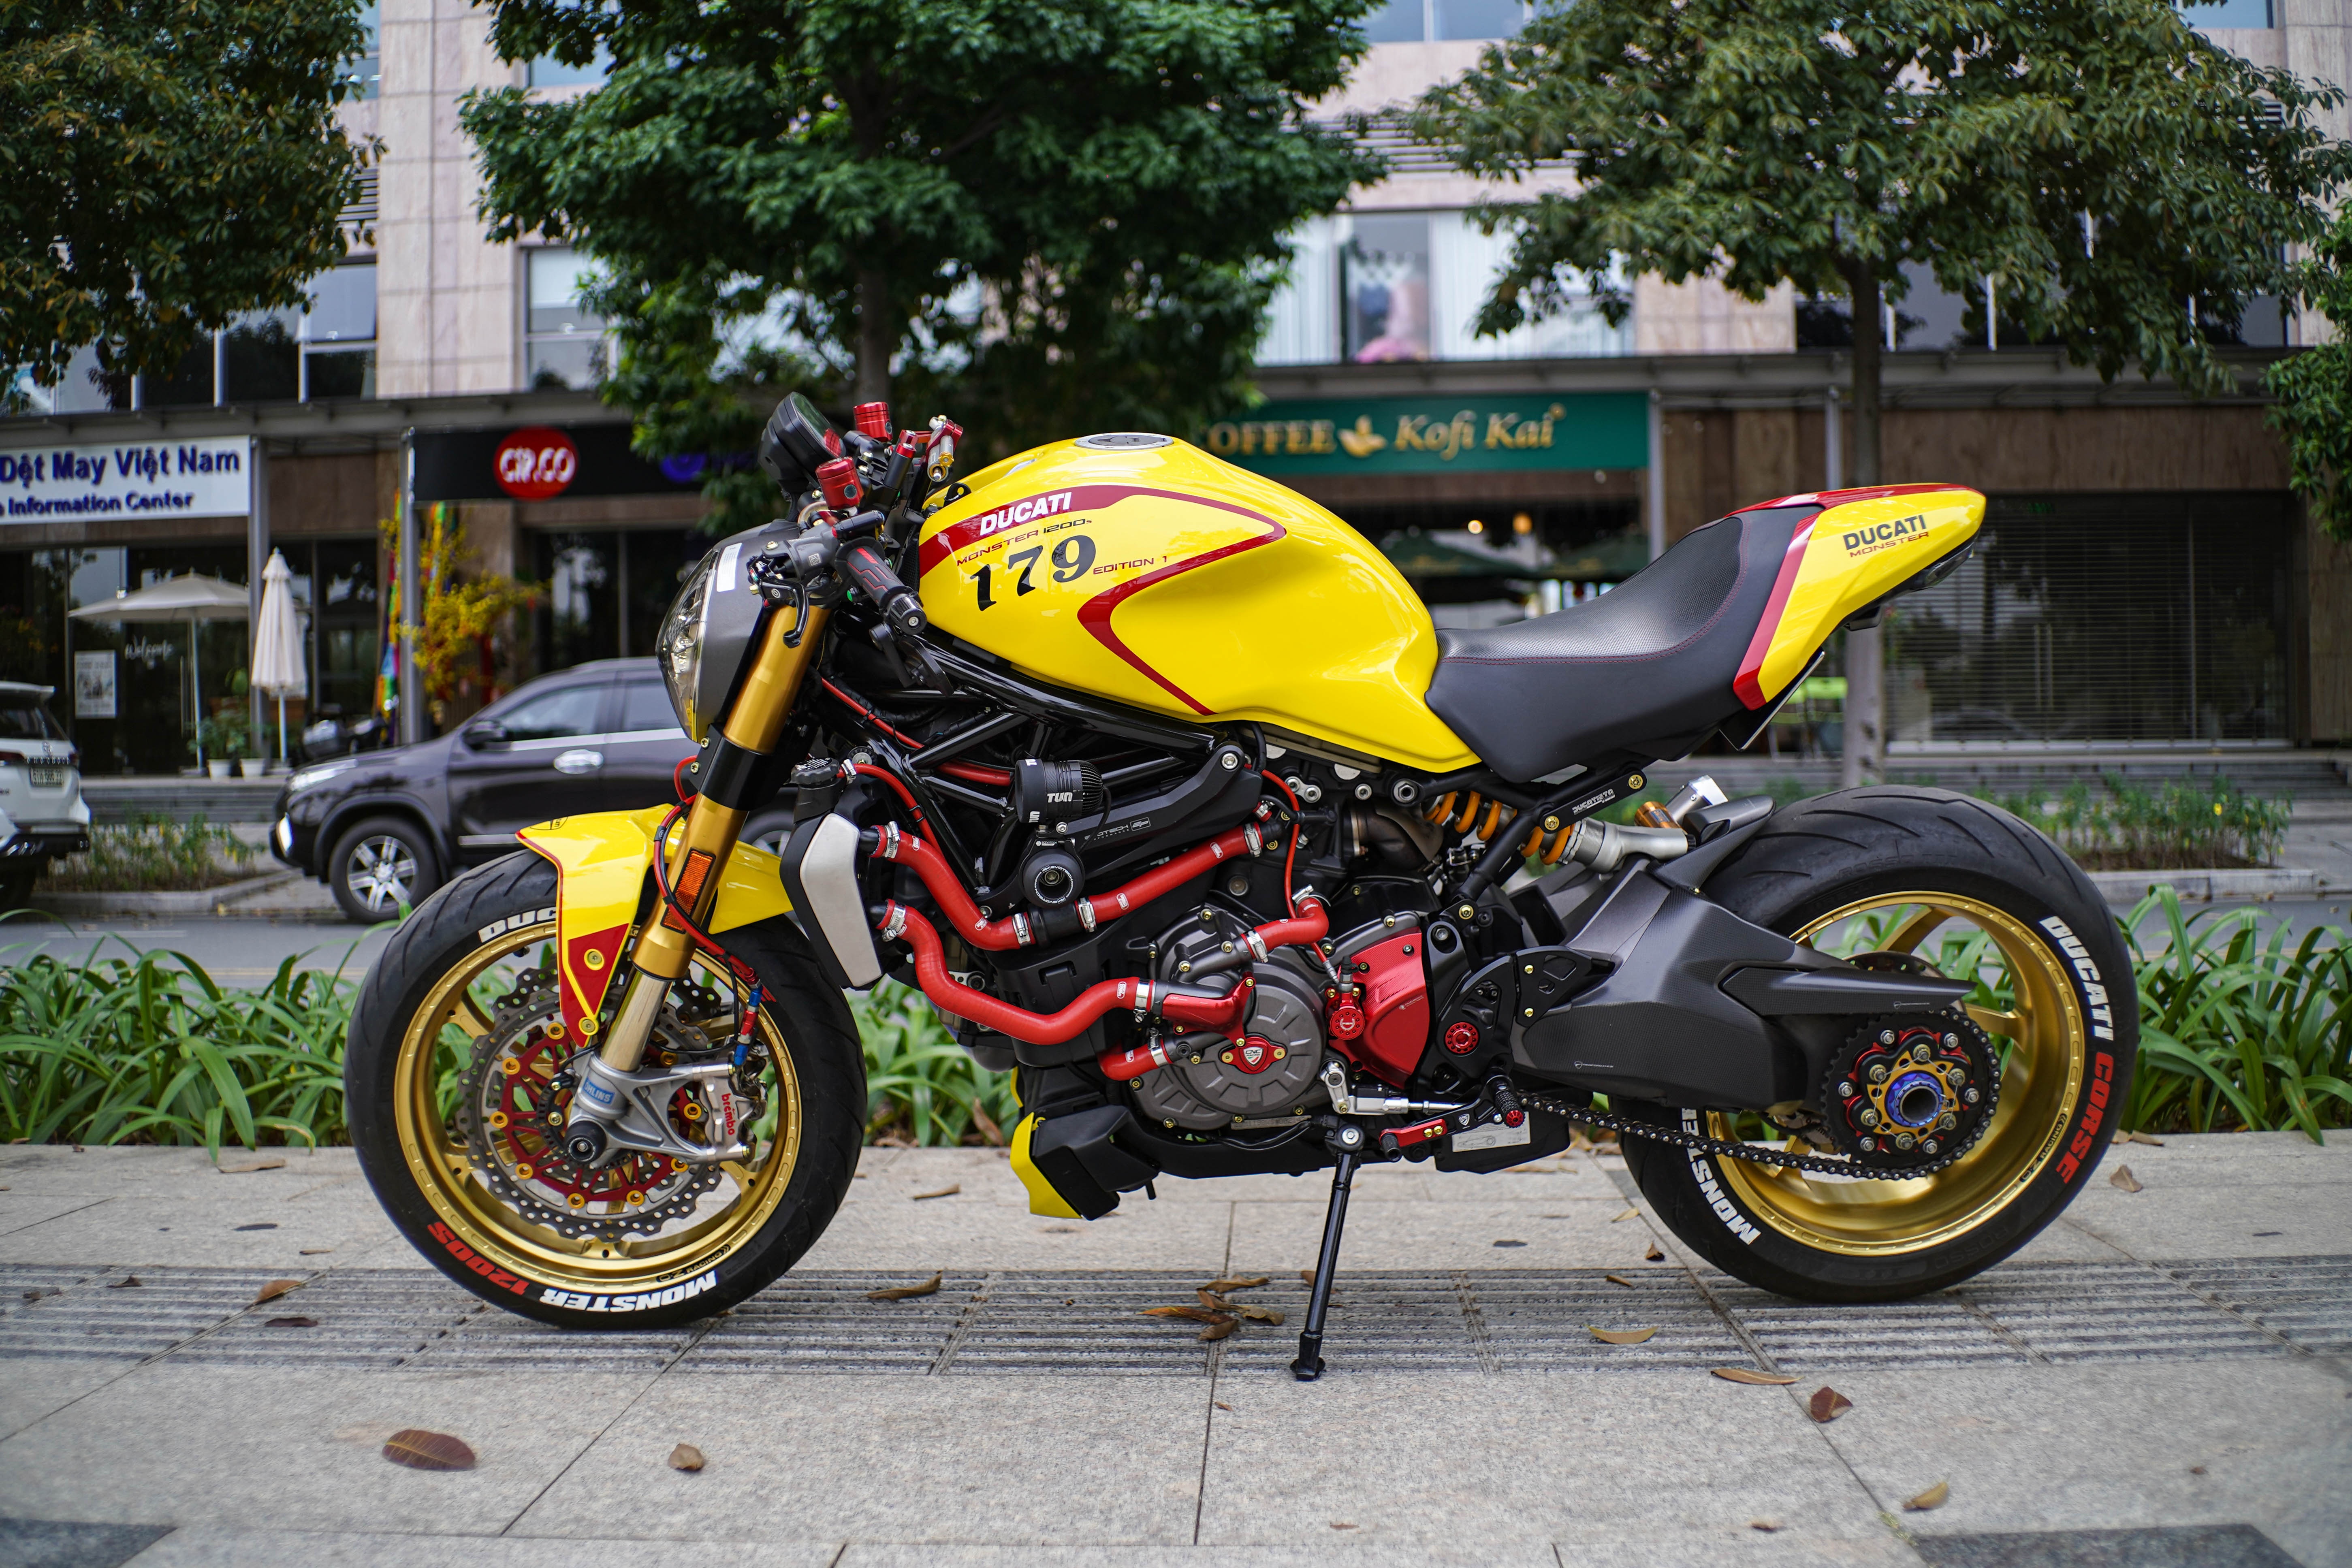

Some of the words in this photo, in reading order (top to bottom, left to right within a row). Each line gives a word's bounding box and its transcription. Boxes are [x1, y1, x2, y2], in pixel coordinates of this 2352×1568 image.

[1202, 420, 1336, 456] OFFEE
[1394, 410, 1477, 461] Kofi
[1483, 410, 1555, 449] Kai
[0, 453, 45, 489] Dệt
[52, 450, 107, 486] May
[114, 446, 170, 484] Việt
[177, 444, 240, 475] Nam
[8, 495, 122, 516] Information
[125, 489, 195, 510] Center
[980, 492, 1072, 536] DUCATI
[957, 530, 1039, 567] MONSTER
[1843, 514, 1927, 550] DUCATI
[1850, 531, 1929, 557] MONSTER
[970, 535, 1096, 612] 179
[1093, 557, 1155, 575] EDITION
[478, 907, 556, 943] DUC
[2039, 915, 2113, 1041] DUCATI
[721, 1093, 736, 1135] brembo
[2056, 1052, 2114, 1183] CORSE
[2040, 1124, 2063, 1159] RACING
[427, 1221, 530, 1295] 1200S
[686, 1252, 722, 1273] RACING
[539, 1270, 717, 1312] MONSTER
